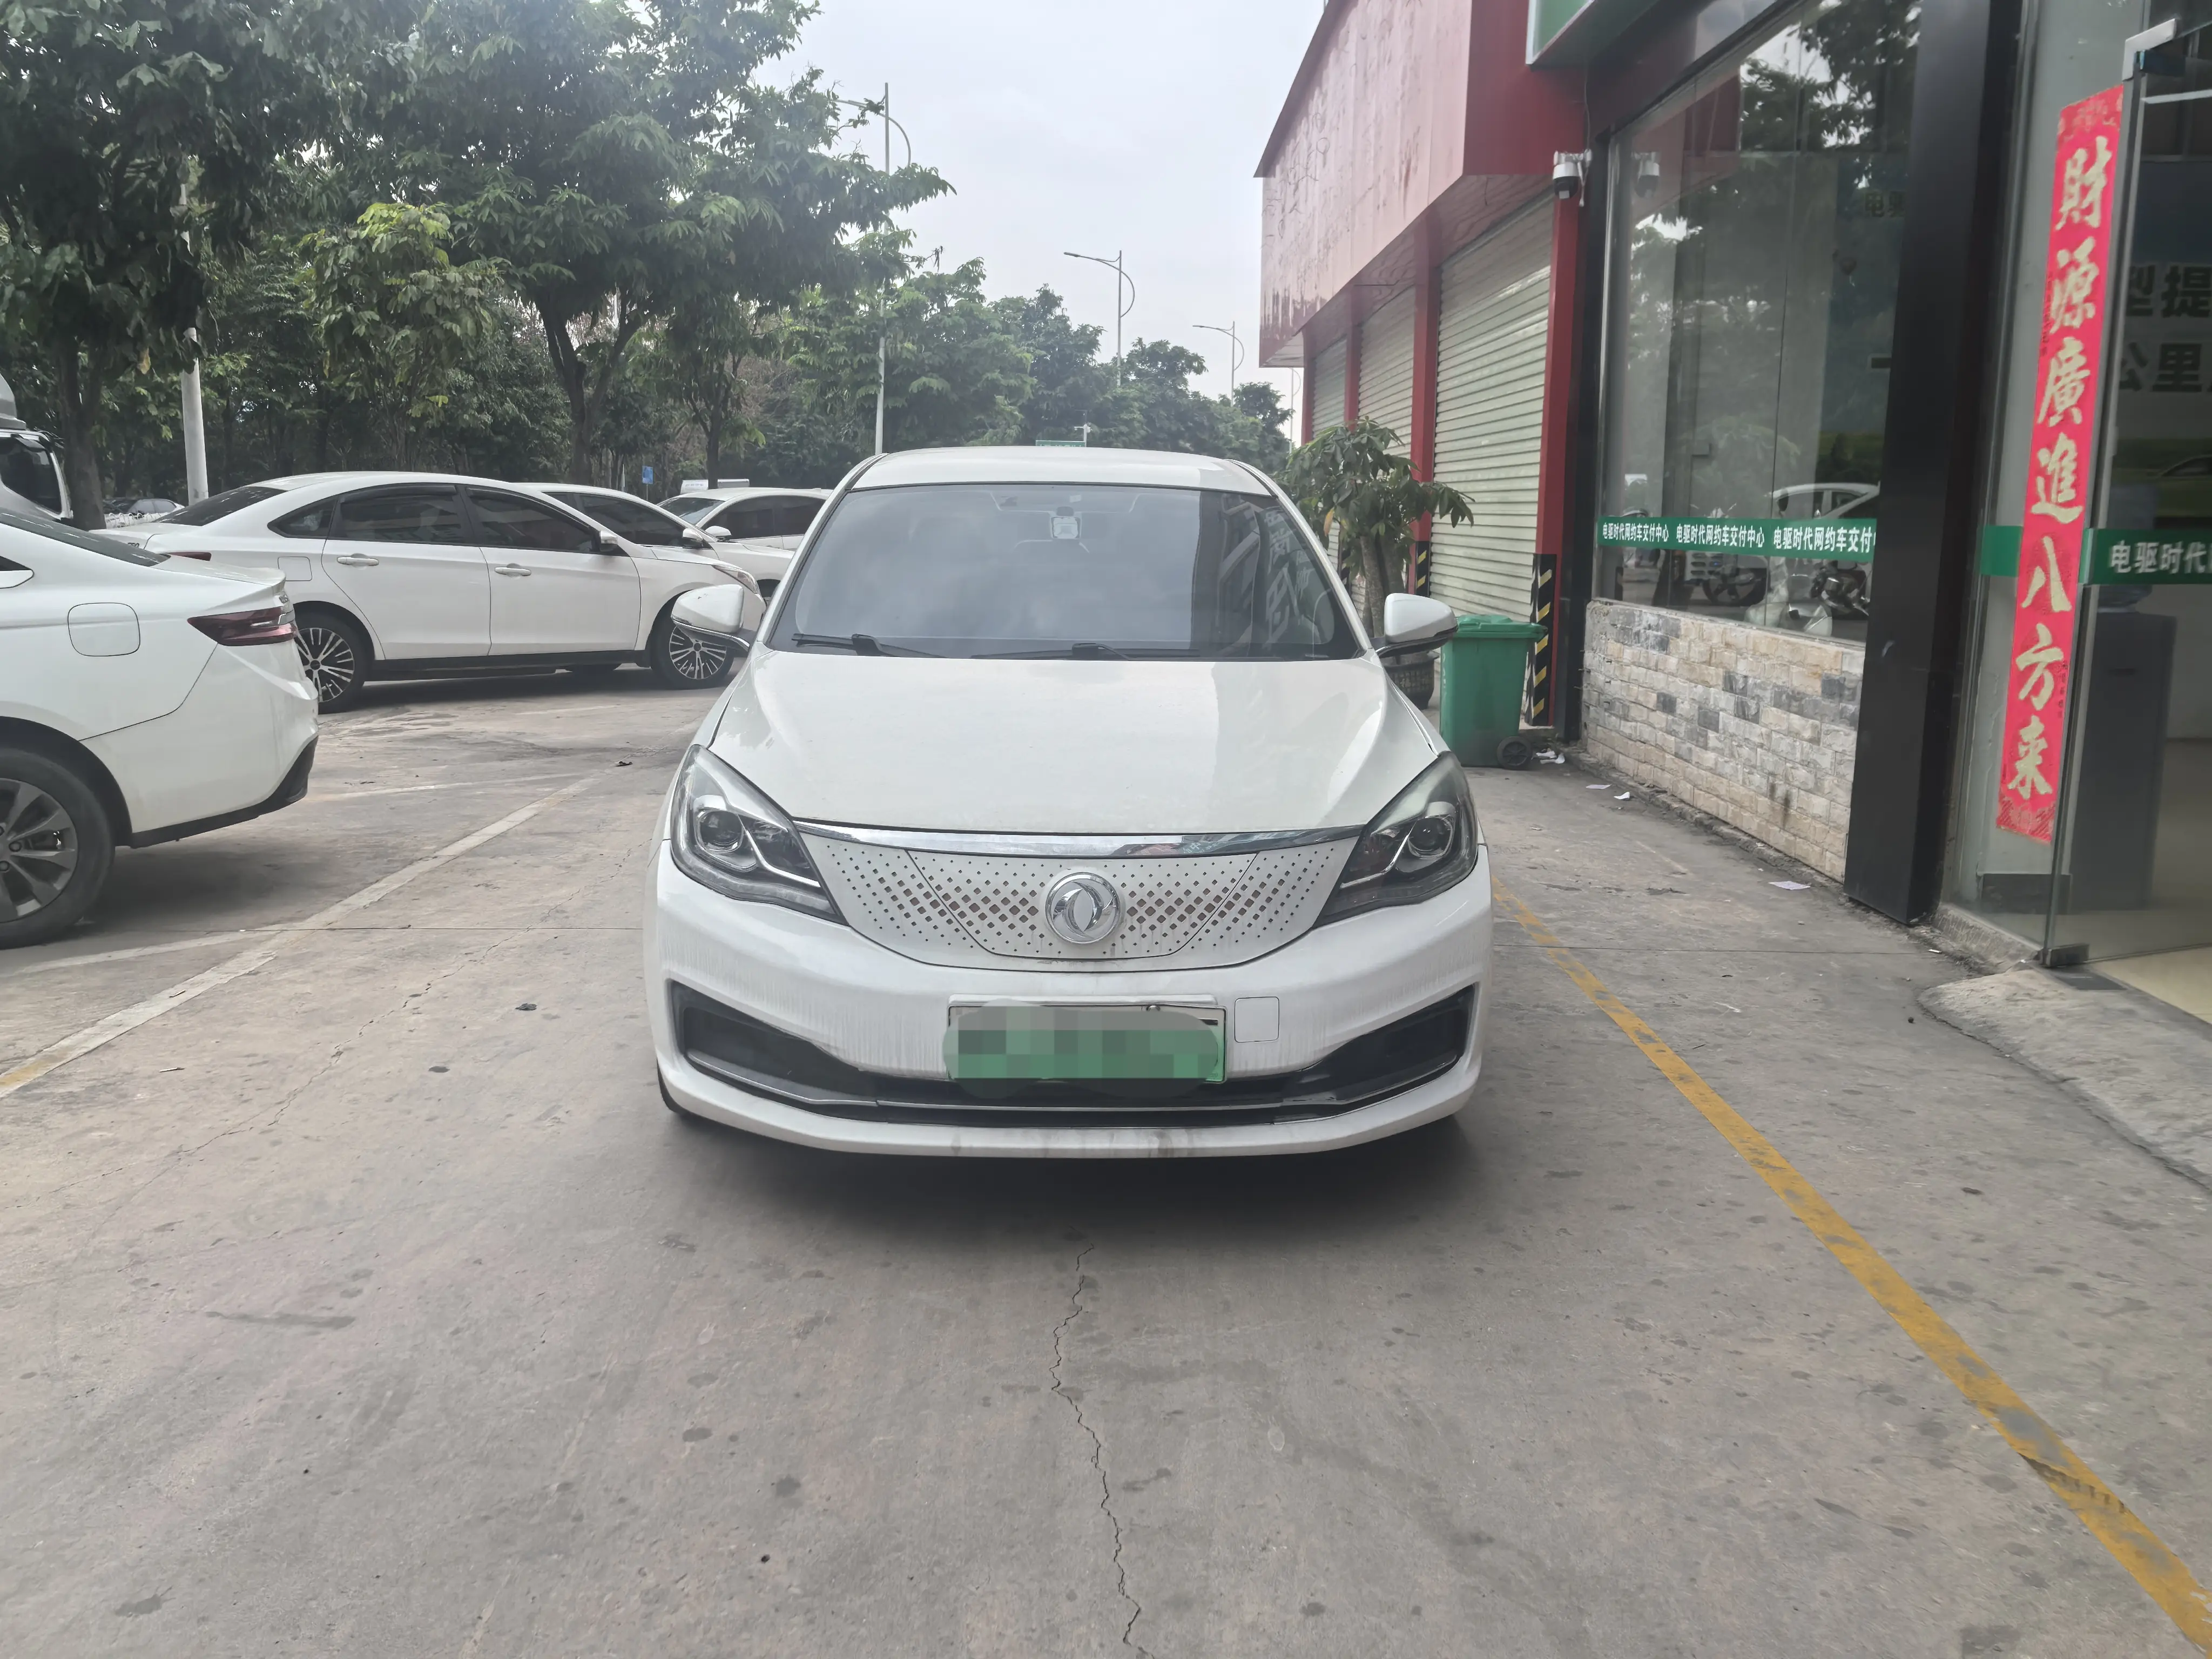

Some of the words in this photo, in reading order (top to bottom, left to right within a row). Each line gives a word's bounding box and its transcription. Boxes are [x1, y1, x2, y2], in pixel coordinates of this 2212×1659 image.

[2119, 342, 2212, 394] 公里
[1602, 522, 1669, 542] 电驱时代网约车交付中心
[1676, 524, 1765, 548] 电驱时代网约车交付中心
[2110, 539, 2212, 574] 电驱时代
